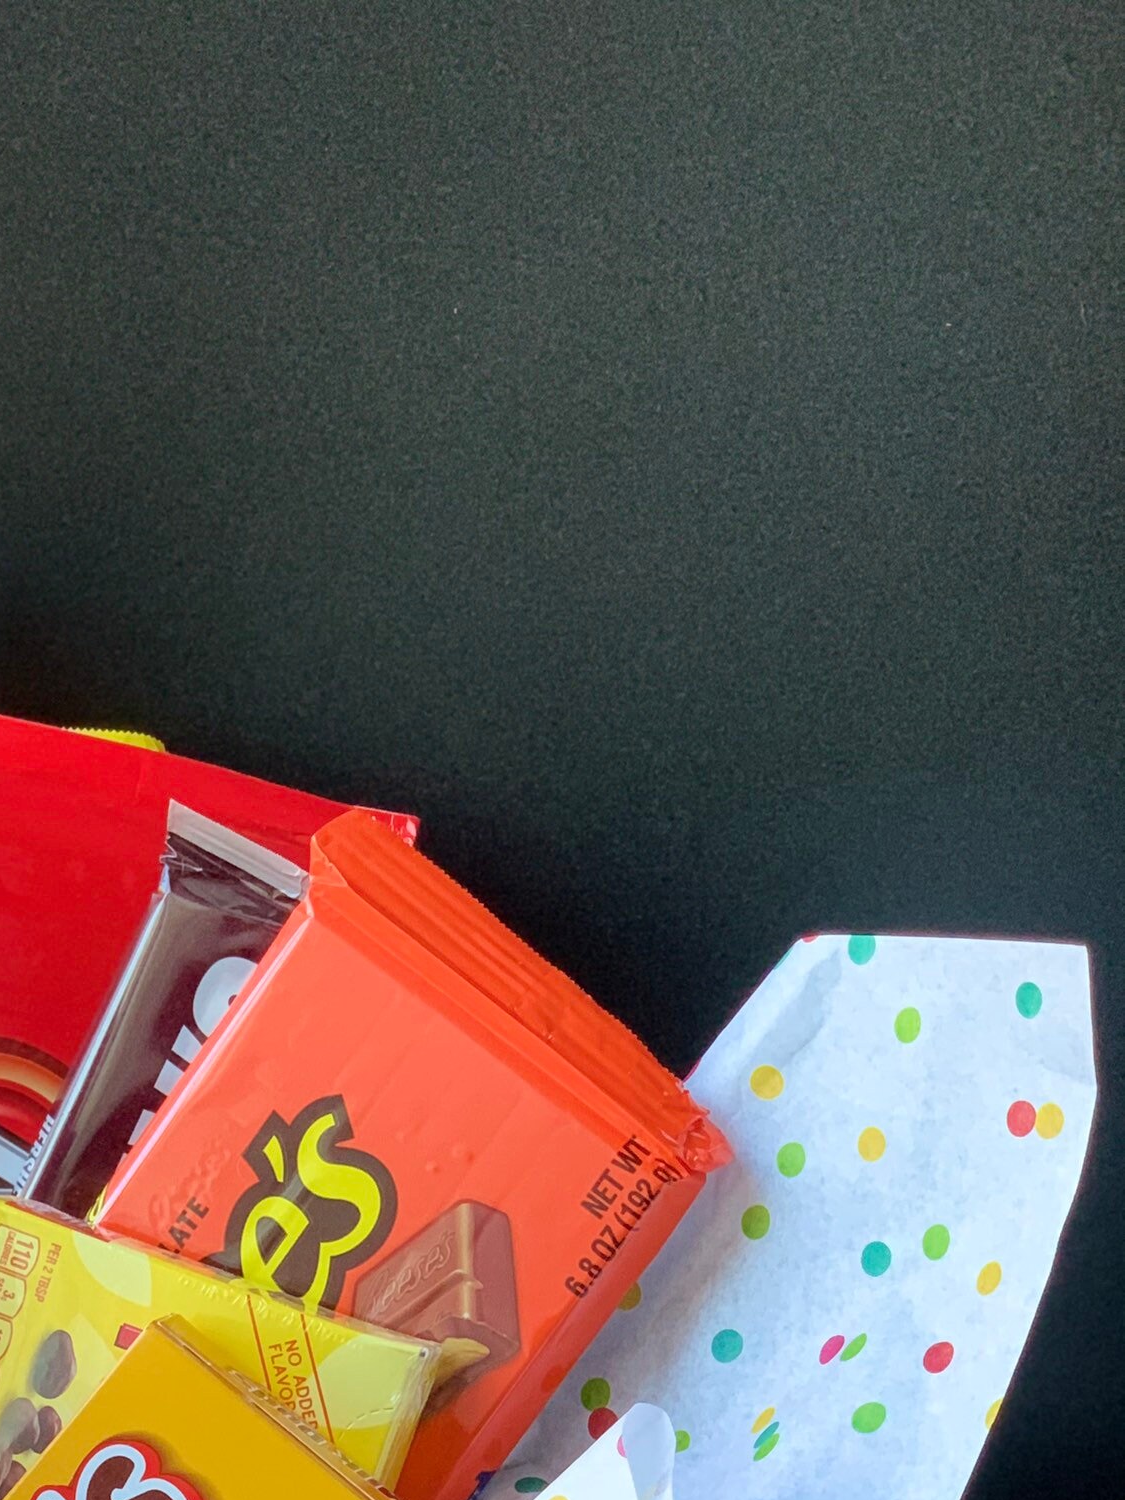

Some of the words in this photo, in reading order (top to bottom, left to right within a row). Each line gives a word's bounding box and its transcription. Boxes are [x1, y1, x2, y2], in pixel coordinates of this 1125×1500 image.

[580, 1168, 624, 1220] NET
[611, 1135, 651, 1174] WT
[0, 1230, 15, 1266] CALORIES
[47, 1242, 62, 1264] PER
[565, 1257, 603, 1298] 6.8
[591, 1225, 626, 1262] OZ
[614, 1178, 661, 1231] (192
[10, 1239, 35, 1271] 110
[43, 1265, 54, 1274] 2
[34, 1274, 52, 1303] TBSP
[285, 1339, 302, 1366] NO
